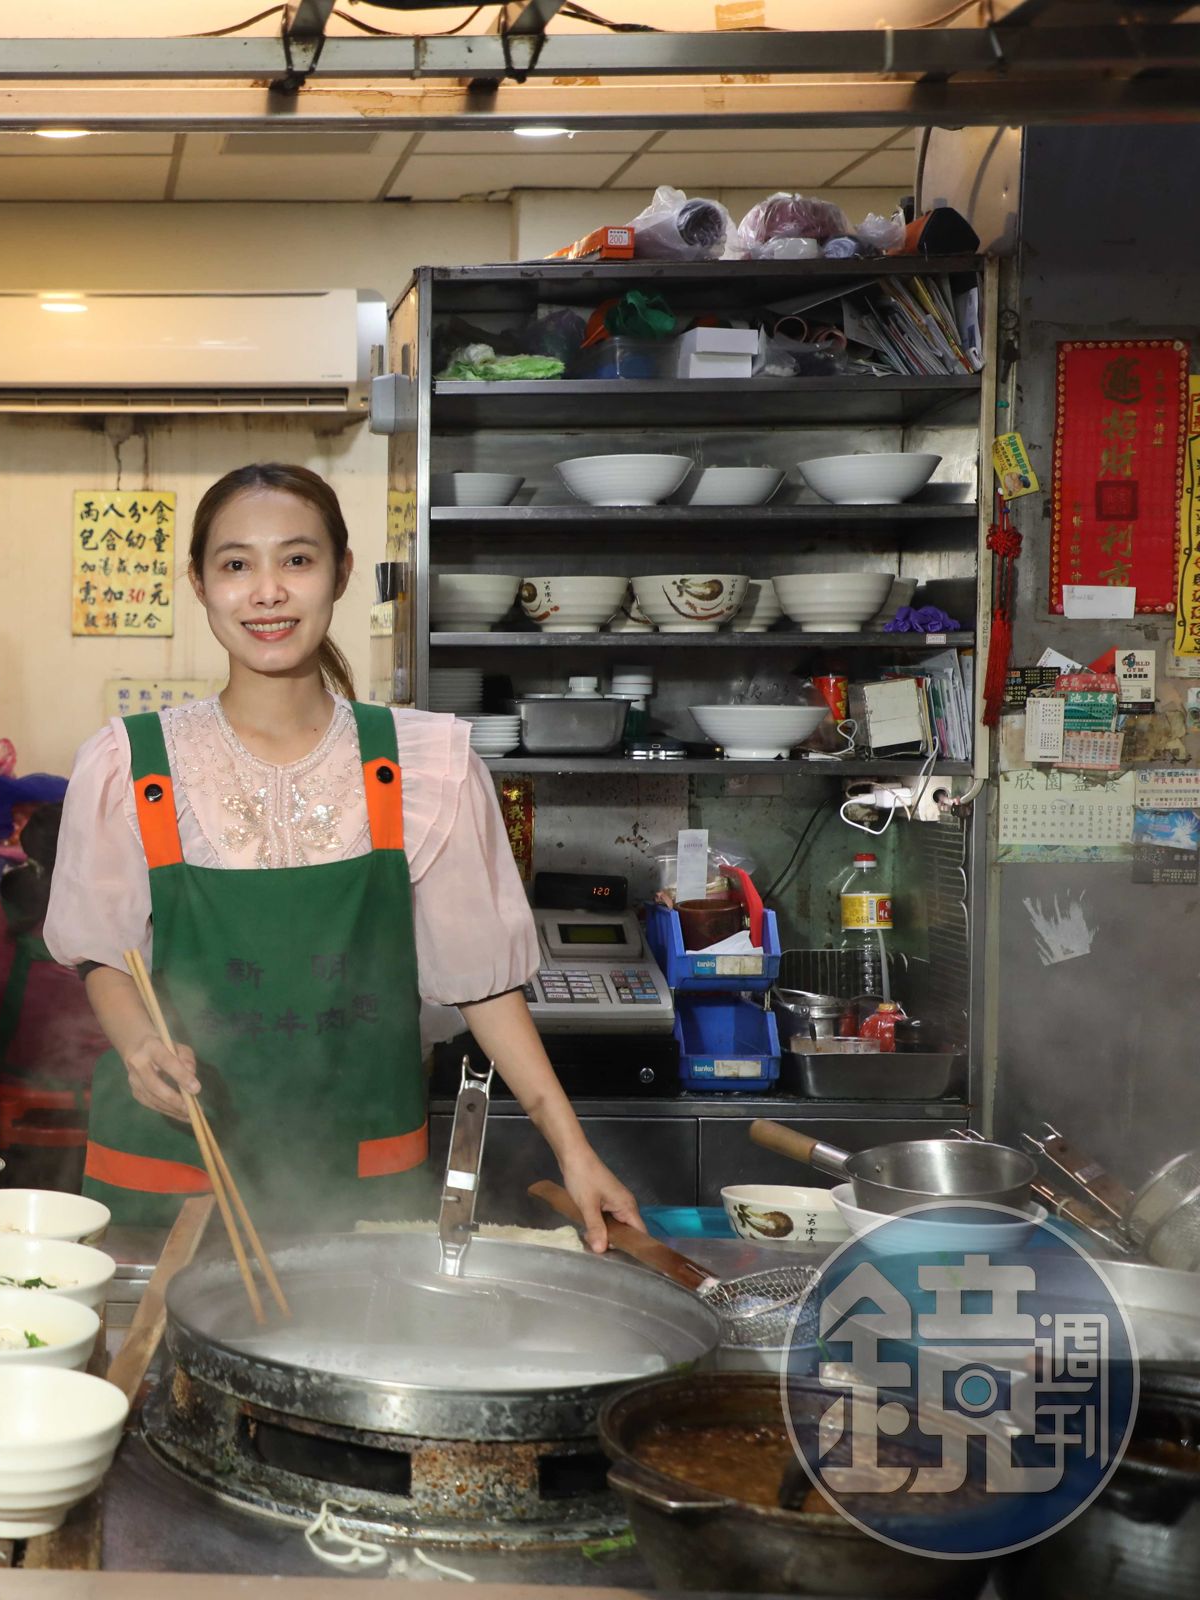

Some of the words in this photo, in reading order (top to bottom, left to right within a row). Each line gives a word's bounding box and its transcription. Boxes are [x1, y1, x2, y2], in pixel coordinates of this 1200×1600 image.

[592, 887, 611, 896] 120
[696, 960, 716, 968] tanko
[693, 1063, 714, 1072] tanko
